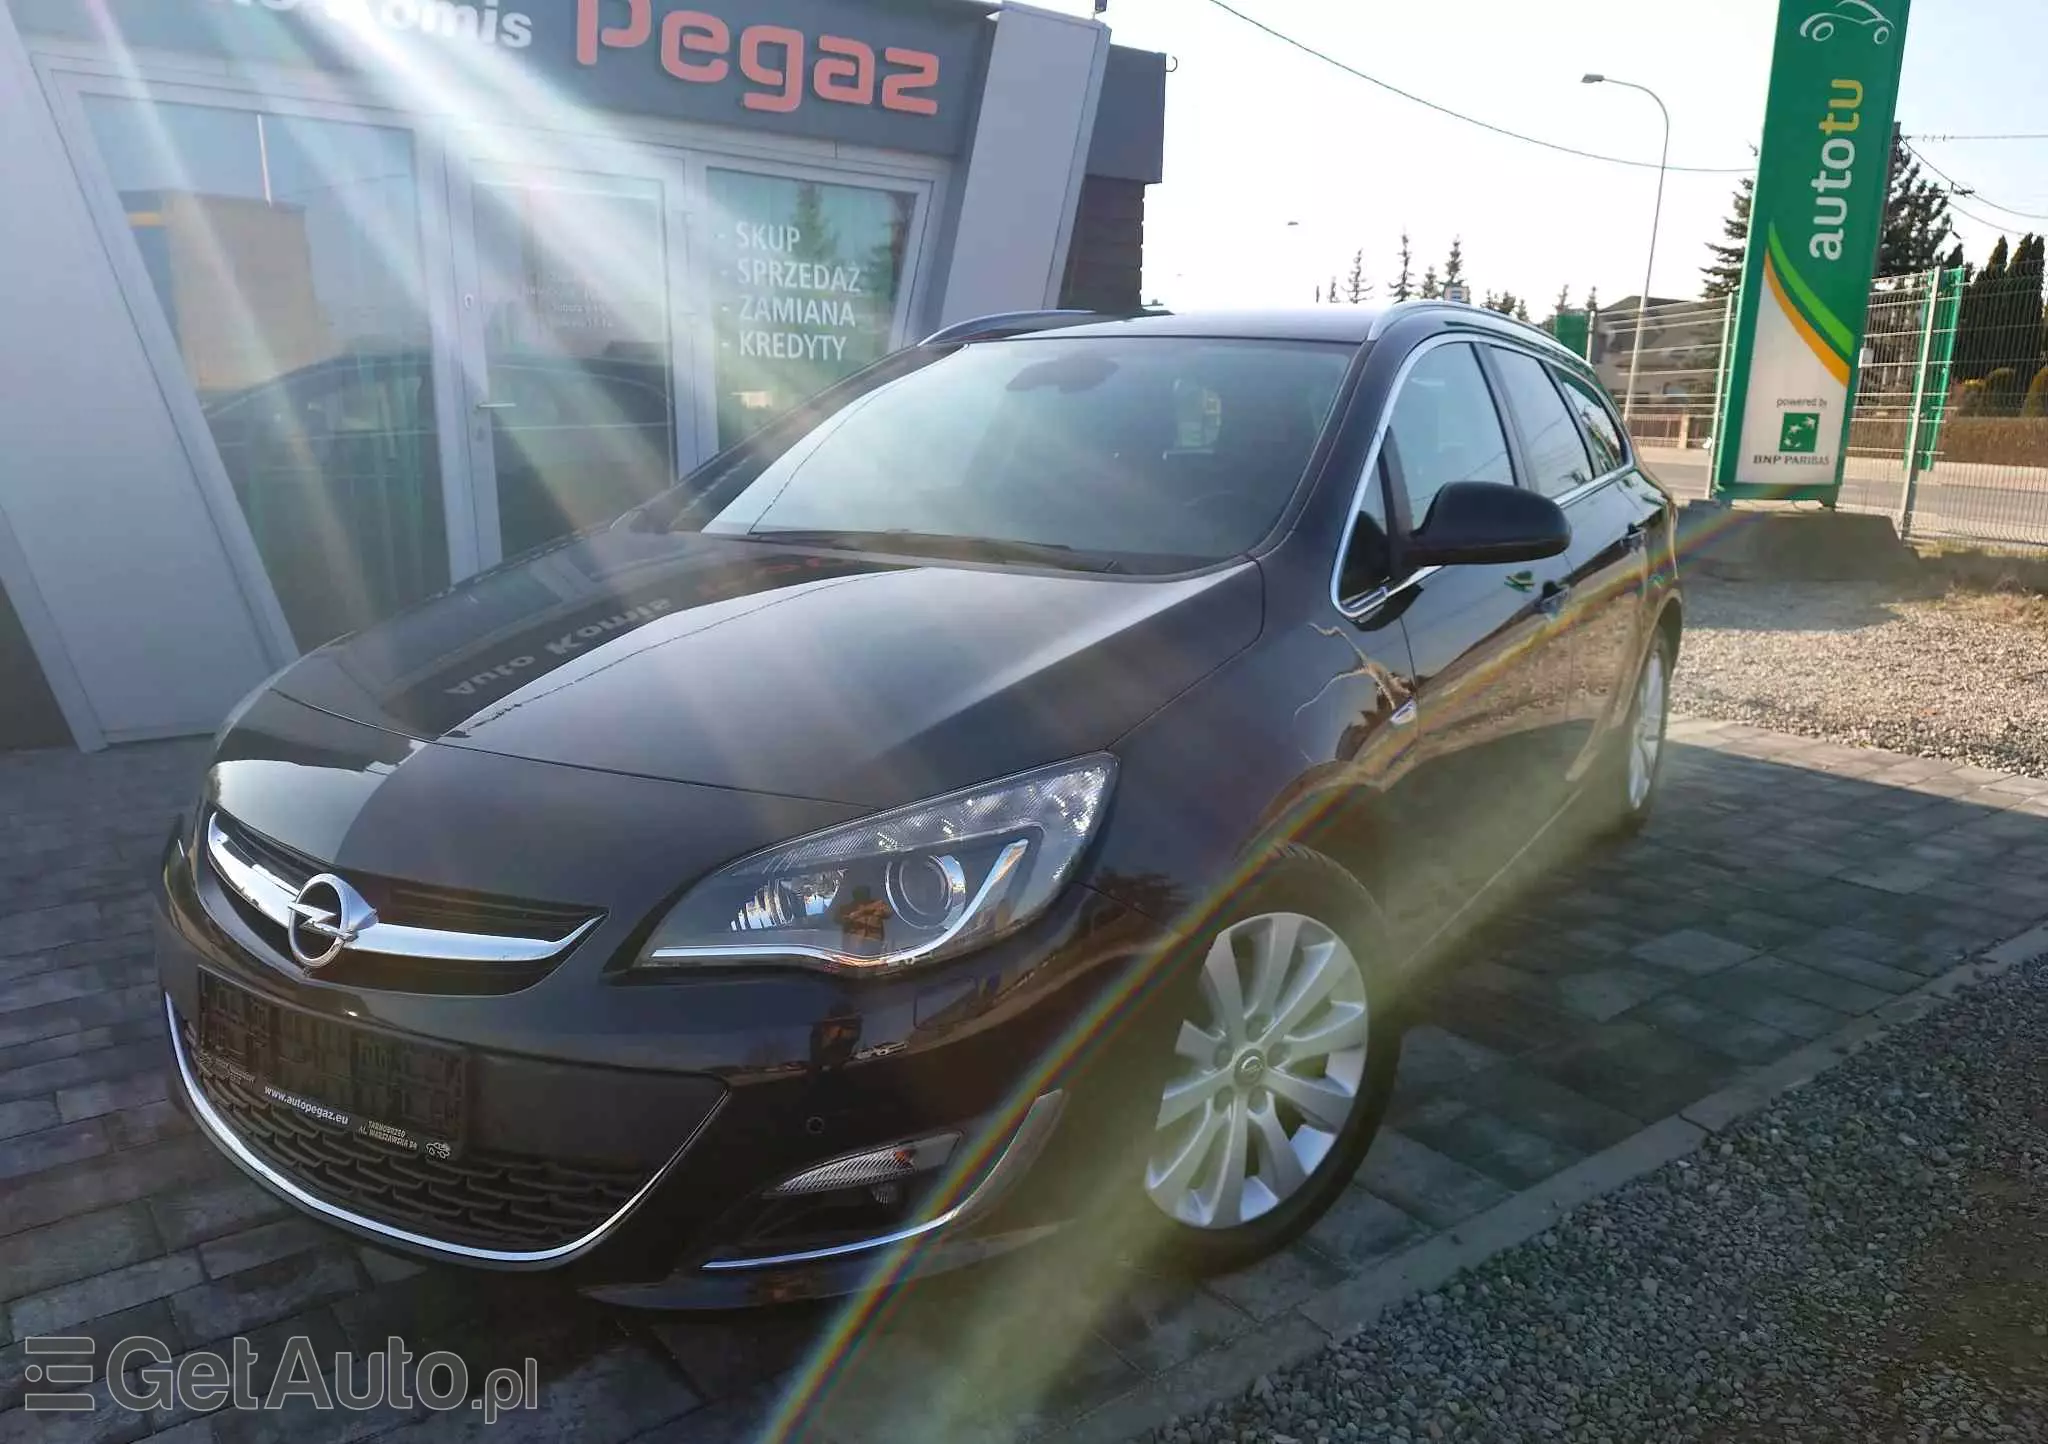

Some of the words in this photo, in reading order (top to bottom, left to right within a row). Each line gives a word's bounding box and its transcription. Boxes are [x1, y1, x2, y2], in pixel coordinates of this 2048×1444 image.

[366, 0, 532, 48] omis
[1809, 79, 1864, 261] autotu
[736, 221, 800, 252] SKUP
[737, 257, 862, 292] SPRZEDAŻ
[739, 294, 856, 327] ZAMIANA
[739, 330, 847, 361] KREDYTY
[1776, 398, 1817, 408] powered
[1753, 455, 1781, 465] BNP
[1784, 455, 1829, 465] PARIBAS
[264, 1086, 349, 1125] www.autopegaz.eu
